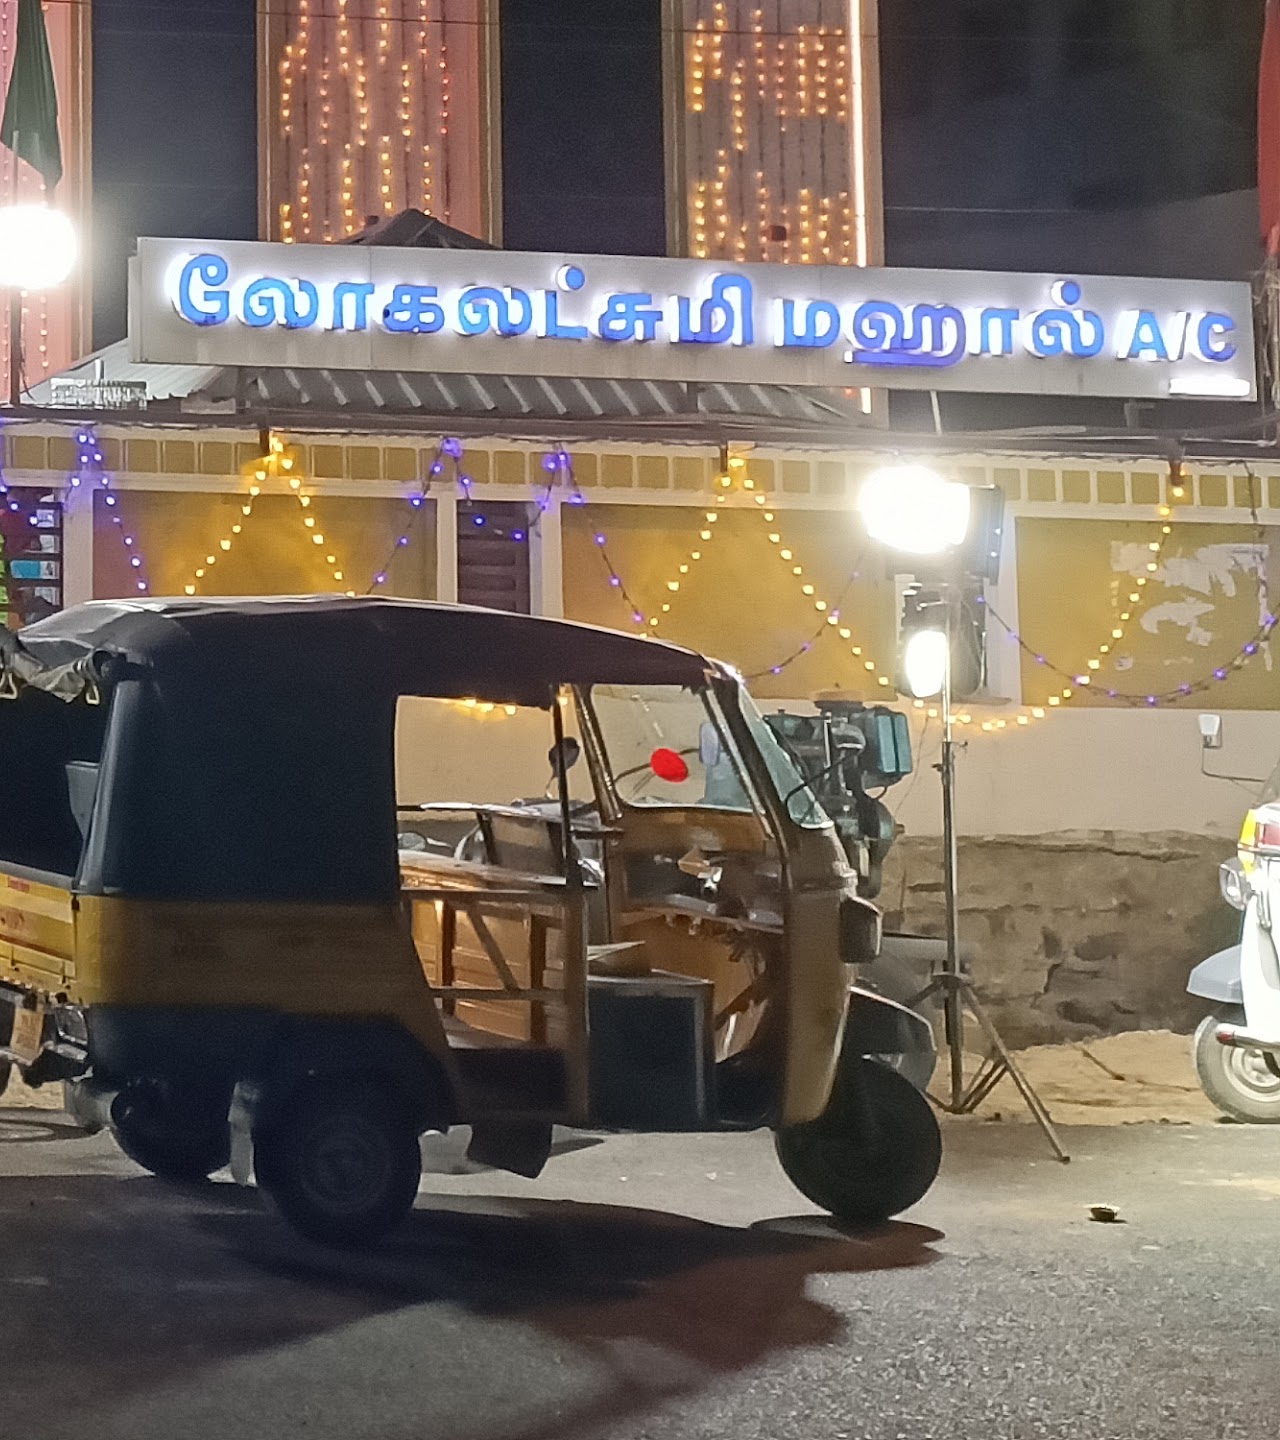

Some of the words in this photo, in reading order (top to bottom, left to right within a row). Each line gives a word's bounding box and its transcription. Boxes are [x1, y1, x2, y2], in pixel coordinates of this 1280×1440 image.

[174, 252, 754, 348] லோகலட்சுமி
[774, 280, 1105, 368] மஹால்
[1117, 309, 1237, 362] A/C
